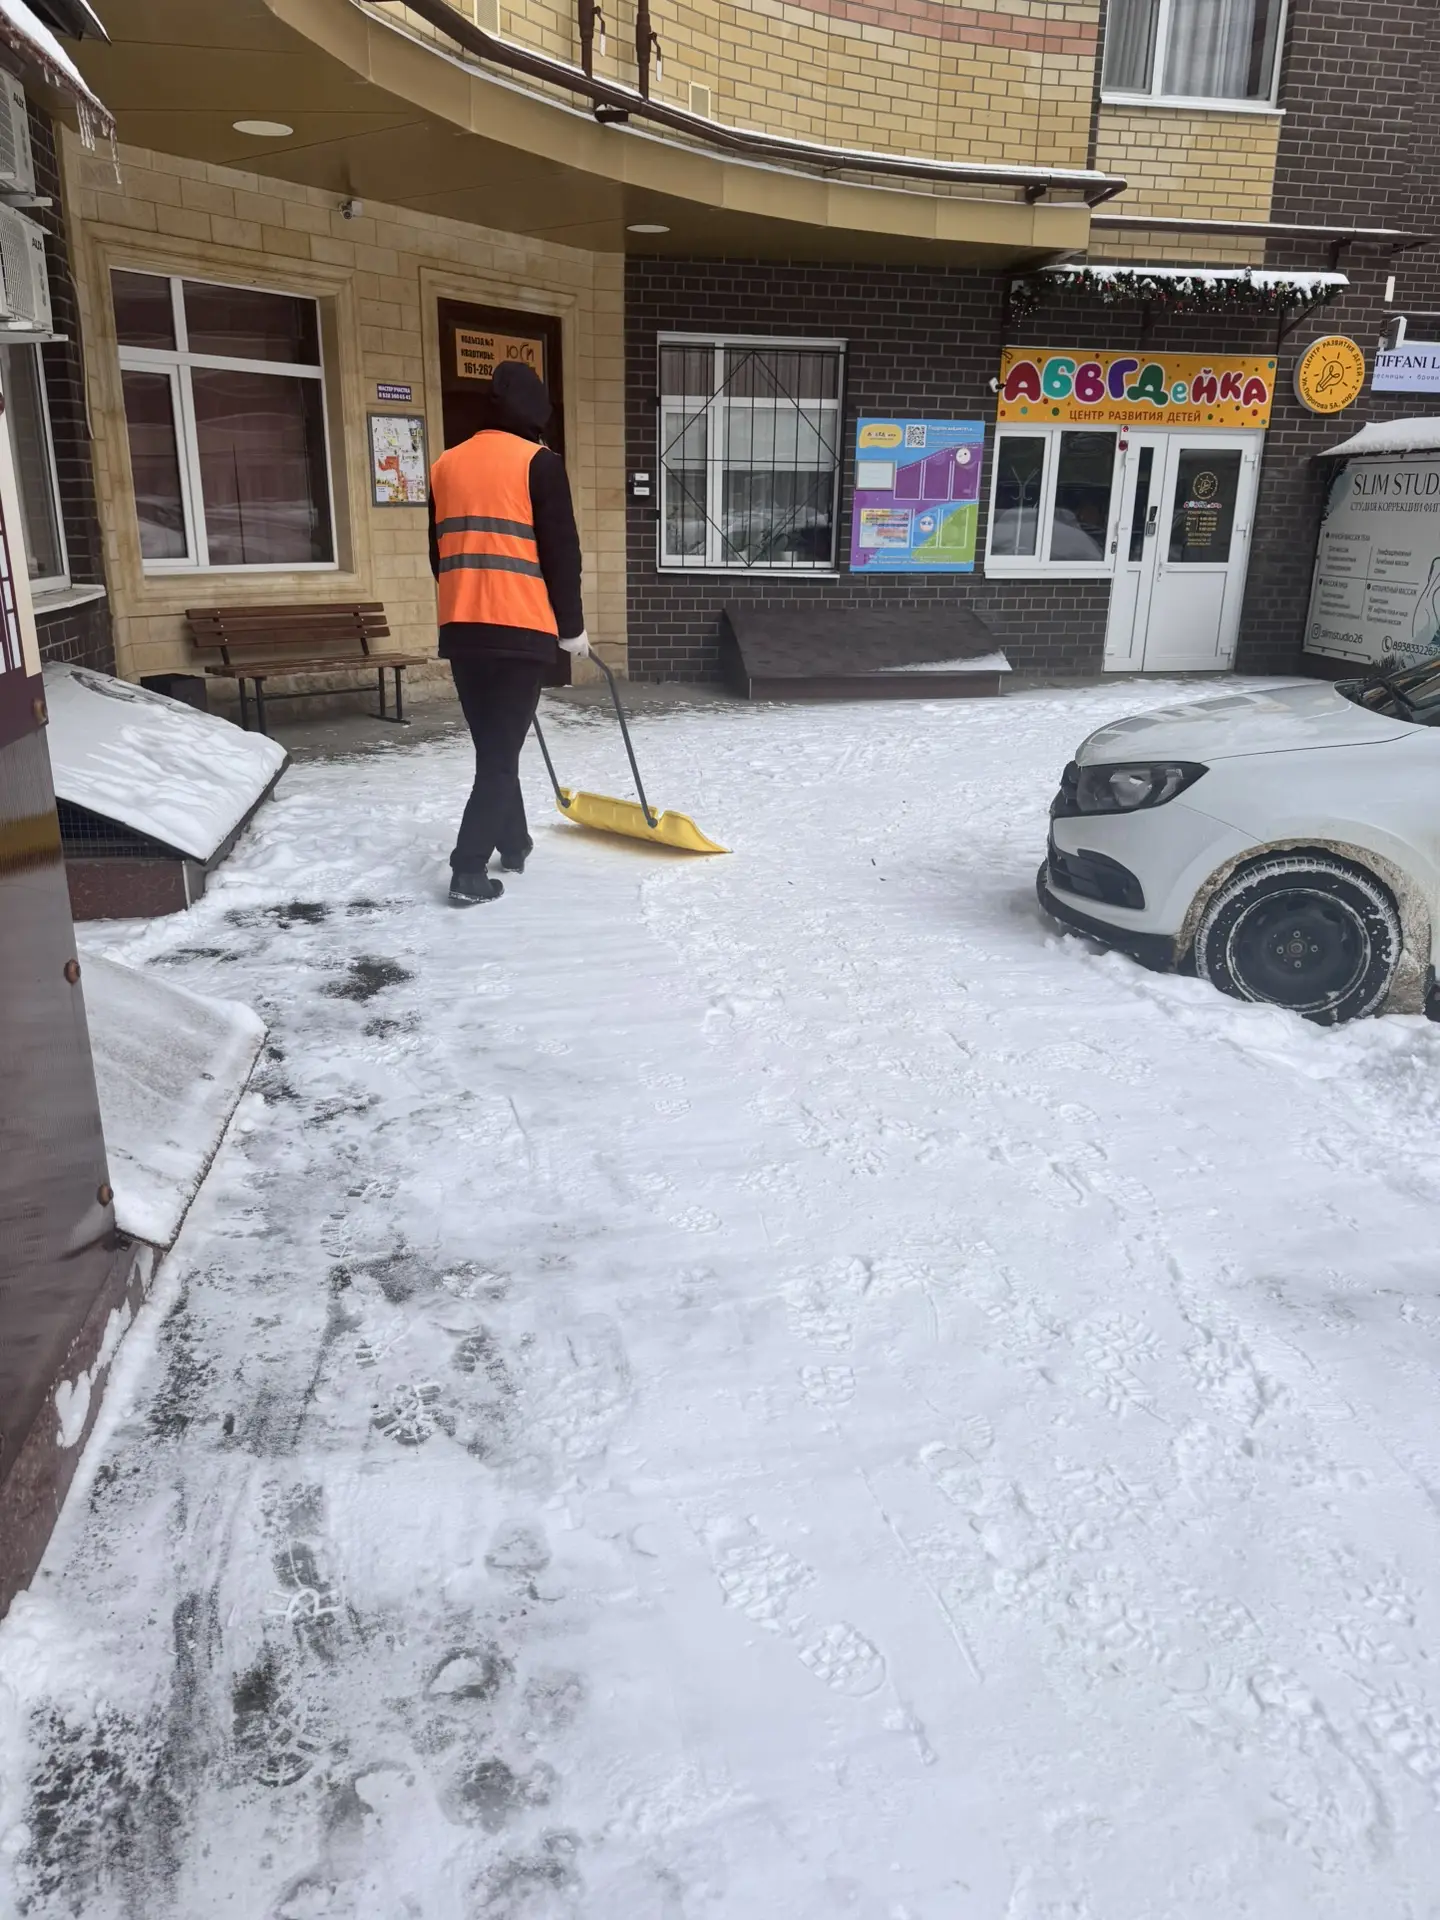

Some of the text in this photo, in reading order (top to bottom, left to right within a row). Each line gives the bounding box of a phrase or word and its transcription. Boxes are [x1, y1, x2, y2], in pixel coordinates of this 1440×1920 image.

[1303, 340, 1363, 376] ЦЕНТР РАЗВИТИЯ ДЕТЕЙ
[1375, 355, 1440, 370] TIFFANI L
[464, 362, 493, 376] 161-262
[1069, 410, 1202, 423] ЦЕНТР РАЗВИТИЯ ДЕТЕЙ
[1352, 472, 1440, 496] SLIM STUD
[1350, 502, 1440, 513] СТУДИЯ КОРРЕКЦИИ ФИГ
[1320, 629, 1363, 644] slimstudio26
[1392, 640, 1440, 657] 8938332269
